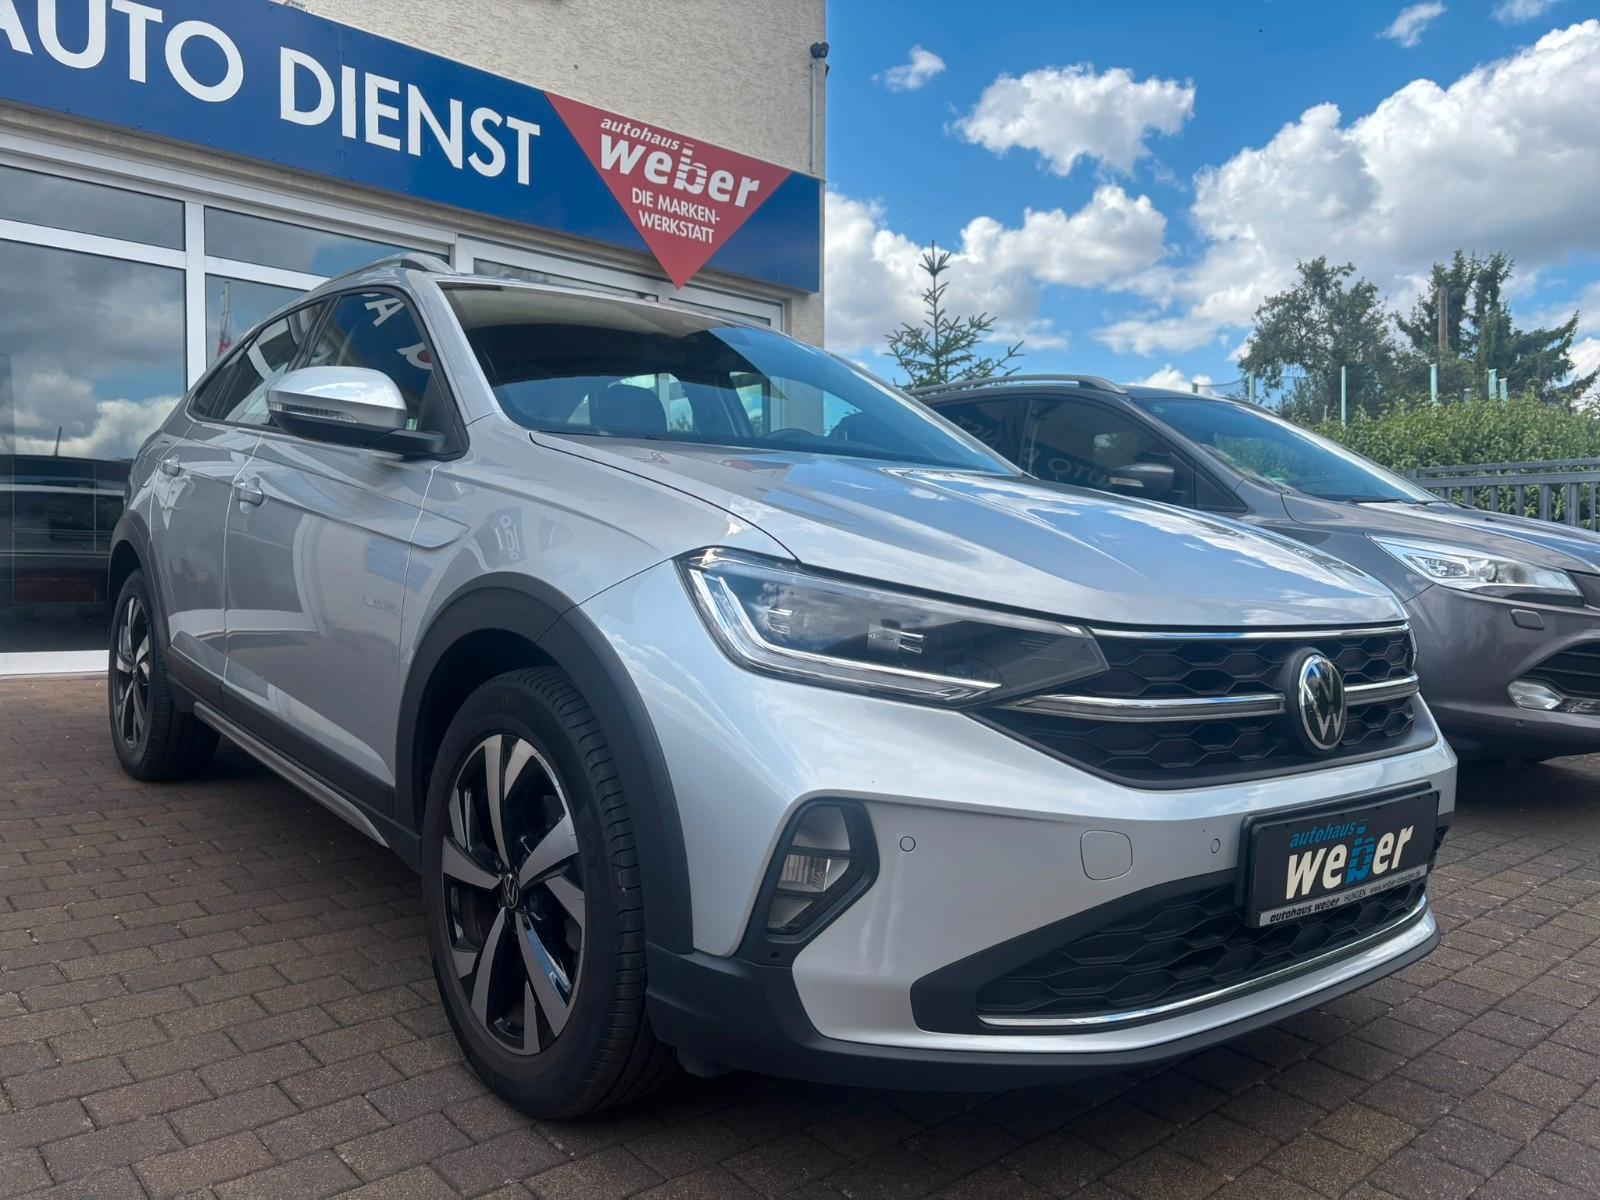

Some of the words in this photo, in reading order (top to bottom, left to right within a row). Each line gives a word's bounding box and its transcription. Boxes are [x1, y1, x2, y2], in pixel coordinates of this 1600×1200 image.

[280, 46, 541, 186] DIENST
[600, 117, 680, 151] autohaus
[600, 133, 760, 208] weber
[631, 186, 654, 208] DIE
[657, 194, 721, 224] MARKEN-
[638, 209, 715, 244] WERKSTATT
[1289, 821, 1357, 849] autohaus
[1285, 823, 1415, 900] weber
[1269, 904, 1313, 923] autohaus
[1314, 897, 1341, 912] weber
